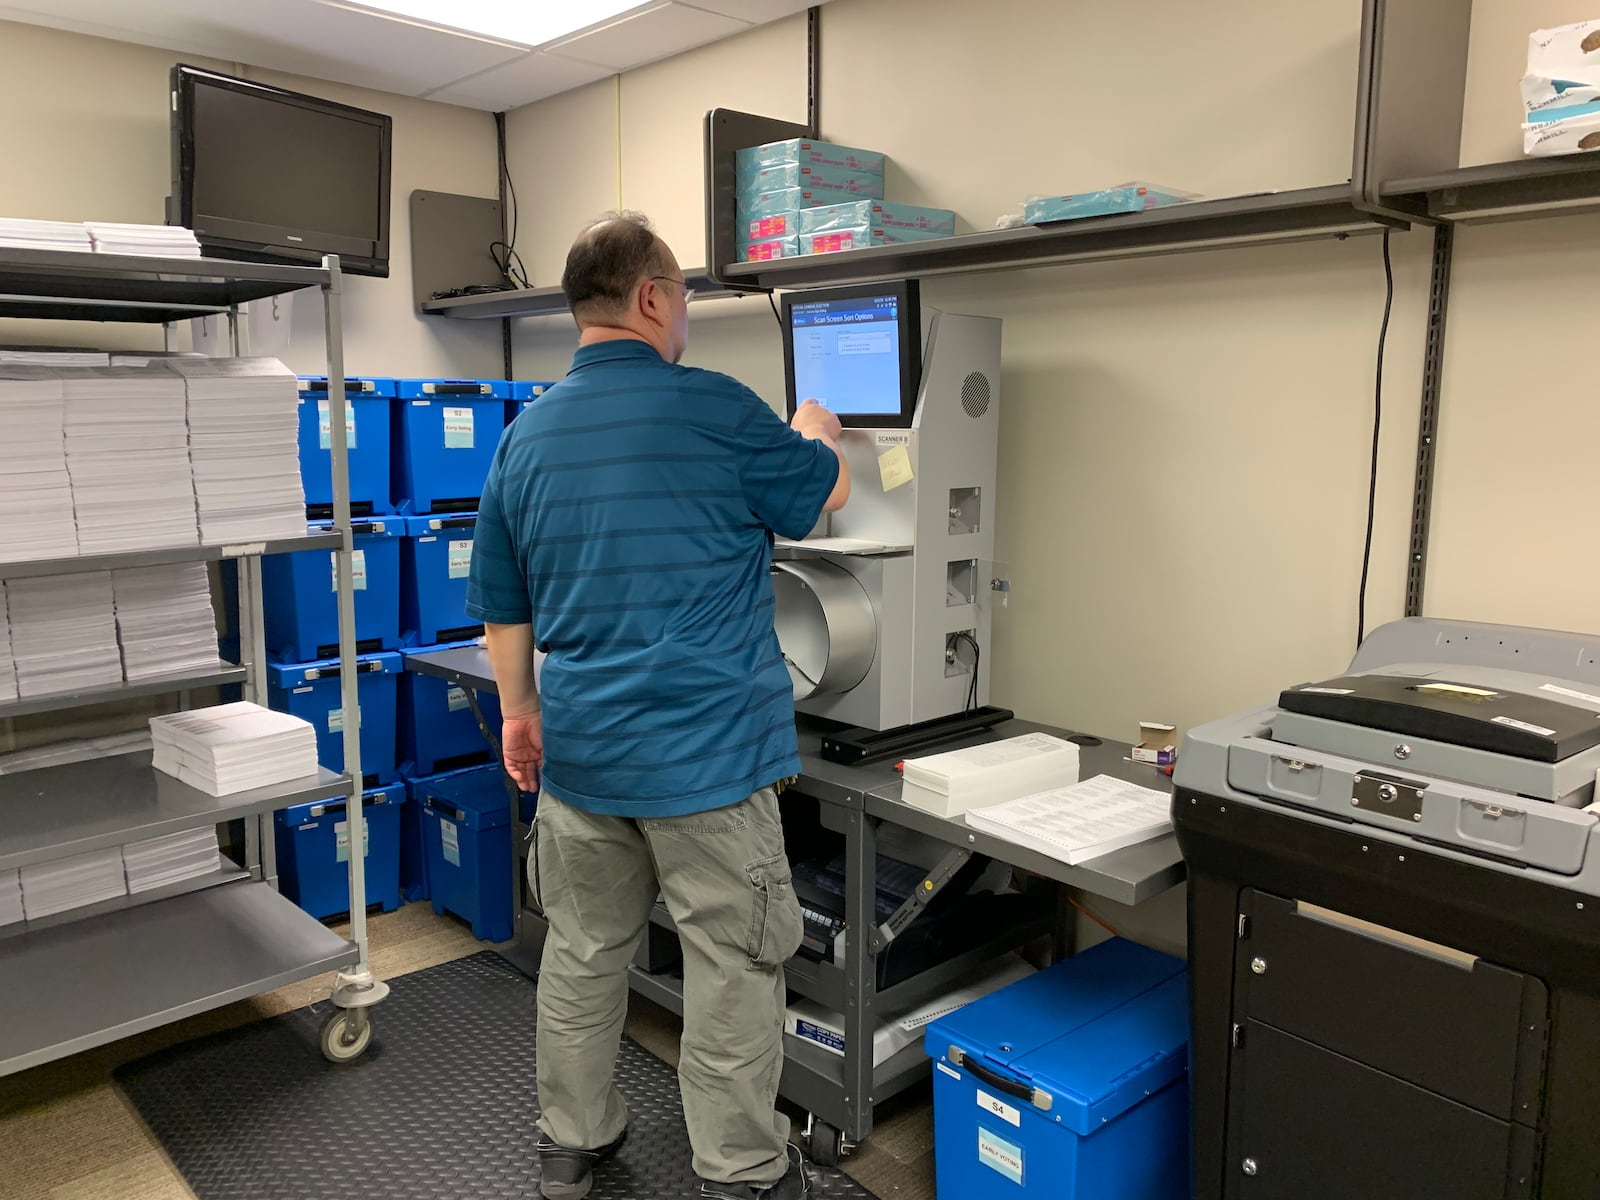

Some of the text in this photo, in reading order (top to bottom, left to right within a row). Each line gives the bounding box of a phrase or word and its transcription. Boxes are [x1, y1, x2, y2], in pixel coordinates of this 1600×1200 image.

[813, 313, 874, 324] Scan Screen Sort Options
[878, 435, 903, 443] SCANNER
[816, 1026, 830, 1036] COPY
[992, 1101, 1004, 1114] S4
[981, 1143, 1020, 1169] EARLY VOTING
